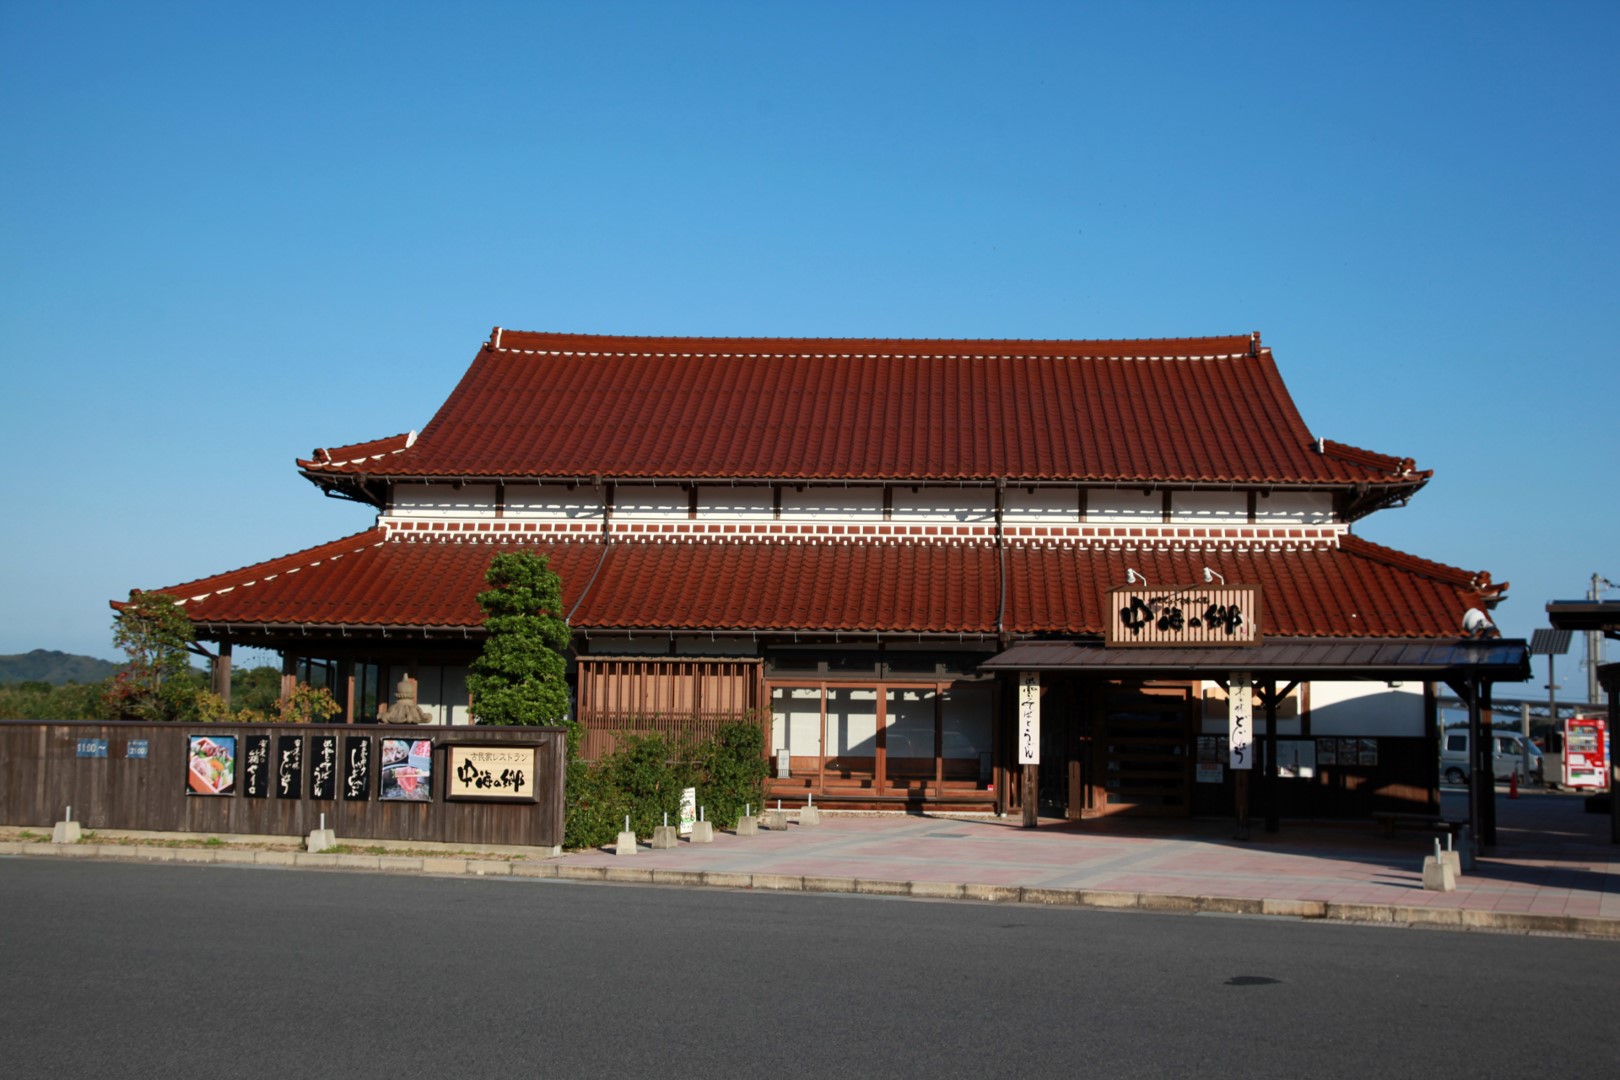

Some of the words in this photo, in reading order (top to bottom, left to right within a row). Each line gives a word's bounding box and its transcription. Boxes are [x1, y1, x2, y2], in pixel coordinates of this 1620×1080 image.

[470, 752, 528, 762] 古民家レストラン
